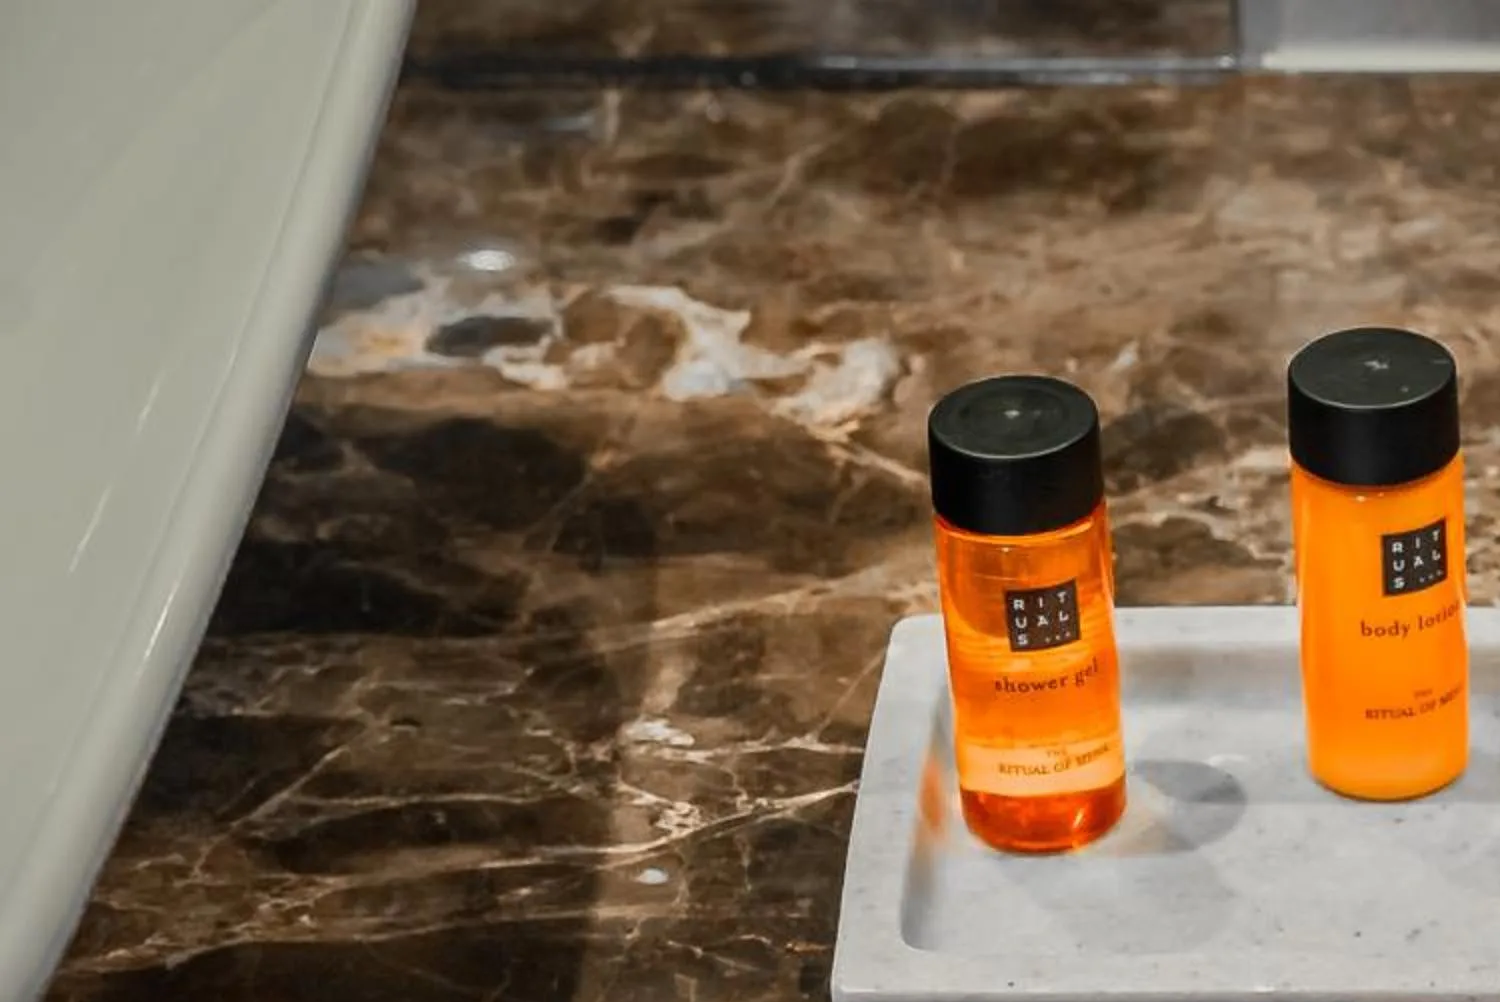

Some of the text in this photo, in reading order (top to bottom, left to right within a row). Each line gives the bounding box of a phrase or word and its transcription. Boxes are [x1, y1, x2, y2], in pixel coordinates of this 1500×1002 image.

[1360, 620, 1411, 640] body
[994, 656, 1099, 694] shower gel
[1365, 707, 1416, 721] RITUAL
[998, 763, 1049, 775] RITUAL
